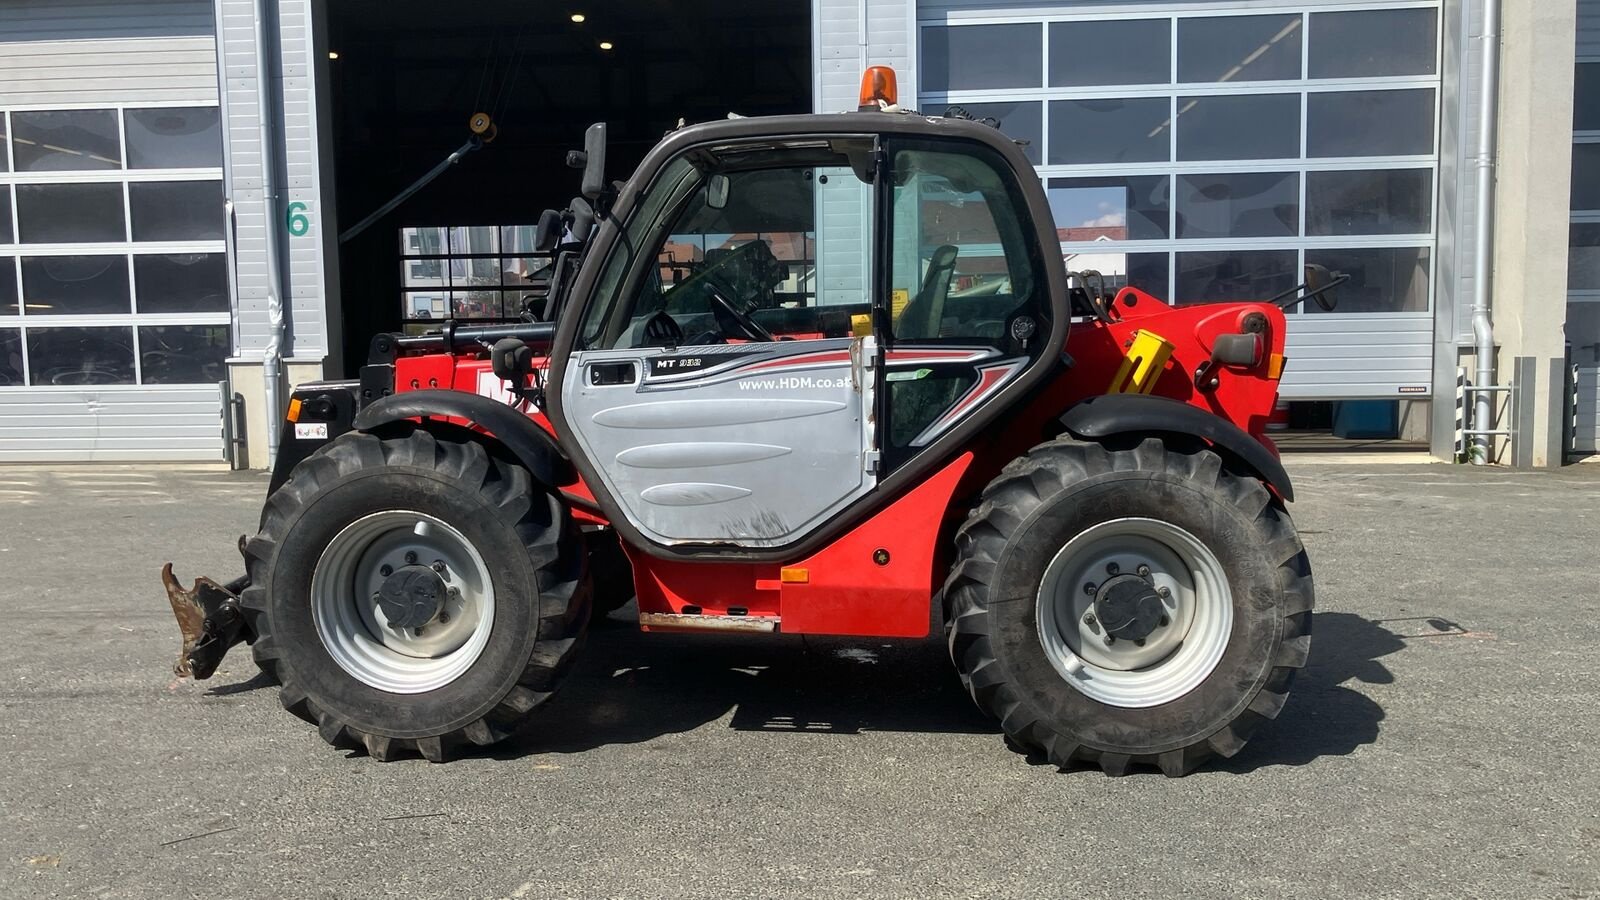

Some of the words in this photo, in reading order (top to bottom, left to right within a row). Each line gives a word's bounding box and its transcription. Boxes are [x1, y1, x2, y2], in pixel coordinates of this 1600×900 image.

[287, 201, 309, 237] 6
[657, 360, 676, 368] MT
[738, 376, 851, 390] www.HDM.co.at
